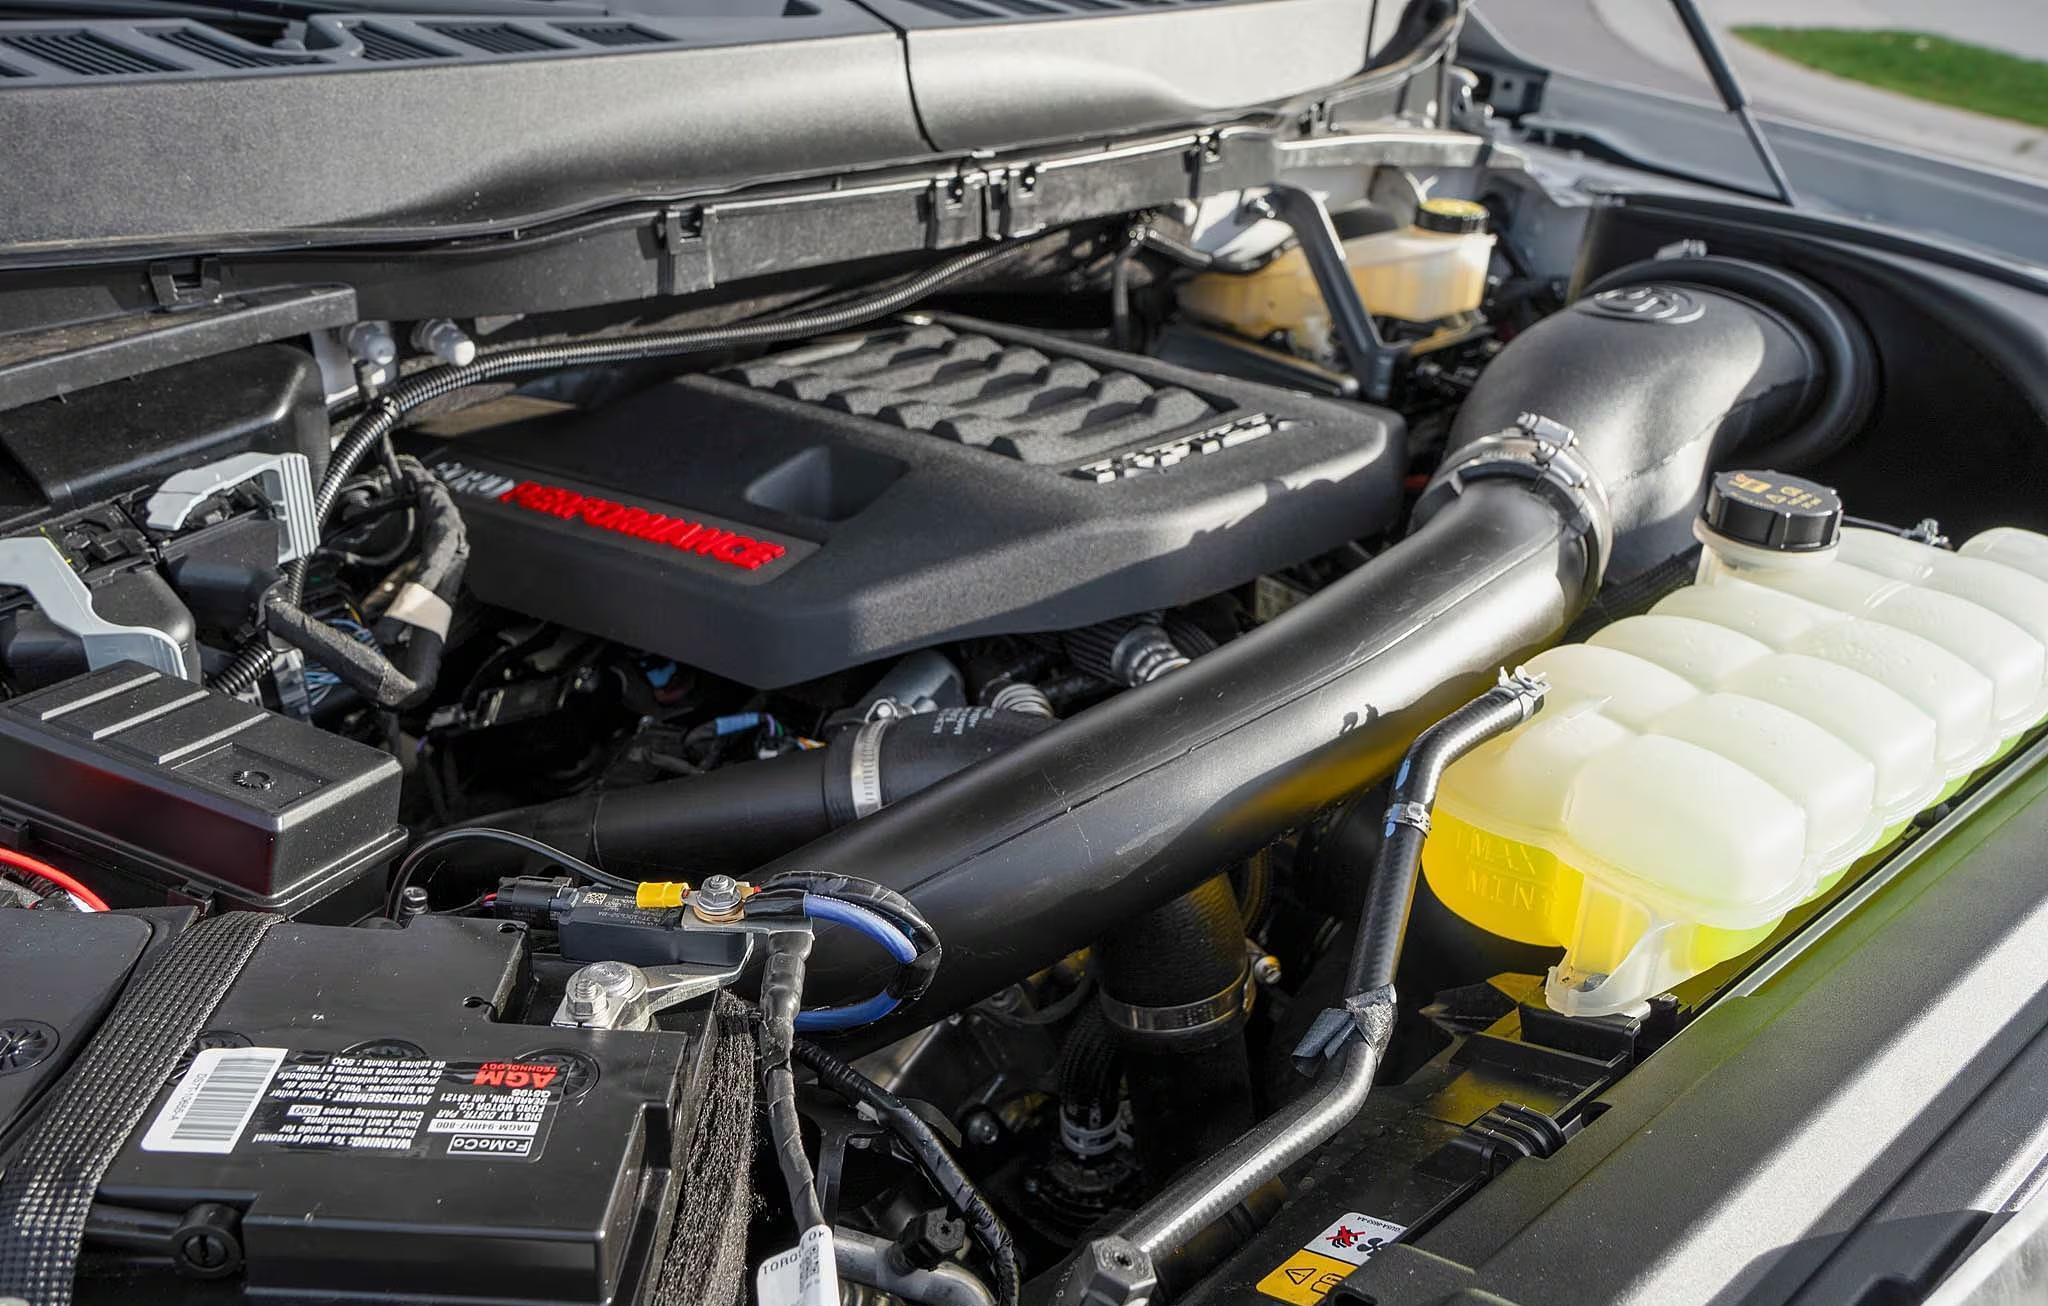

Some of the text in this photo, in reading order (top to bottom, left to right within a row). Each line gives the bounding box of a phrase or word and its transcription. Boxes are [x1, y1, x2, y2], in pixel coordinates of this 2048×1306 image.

[1465, 869, 1536, 911] MIN
[433, 1060, 447, 1070] de
[480, 1062, 558, 1073] TECHNOLOGY
[429, 1069, 443, 1078] de
[472, 1070, 557, 1089] AGM
[297, 1080, 328, 1090] guide
[340, 1083, 362, 1092] Voir
[365, 1085, 416, 1094] blessures.
[300, 1090, 326, 1100] Pour
[415, 1086, 436, 1095] des
[332, 1091, 433, 1105] AVERTISSEMENT
[440, 1092, 549, 1105] DEARBORN, MI 48121
[322, 1105, 353, 1116] amps
[353, 1107, 399, 1118] cranking
[457, 1102, 546, 1113] FORD MOTOR CO.
[398, 1110, 425, 1120] Cold
[435, 1109, 543, 1121] DIST. BY DISTR. PAR
[302, 1116, 366, 1127] instructions.
[366, 1119, 393, 1127] start
[278, 1124, 297, 1132] for
[297, 1125, 329, 1135] guide
[328, 1126, 363, 1135] owner
[363, 1127, 385, 1136] see
[252, 1133, 412, 1150] WARNING: To avoid personal
[453, 1138, 530, 1152] FoMoCo
